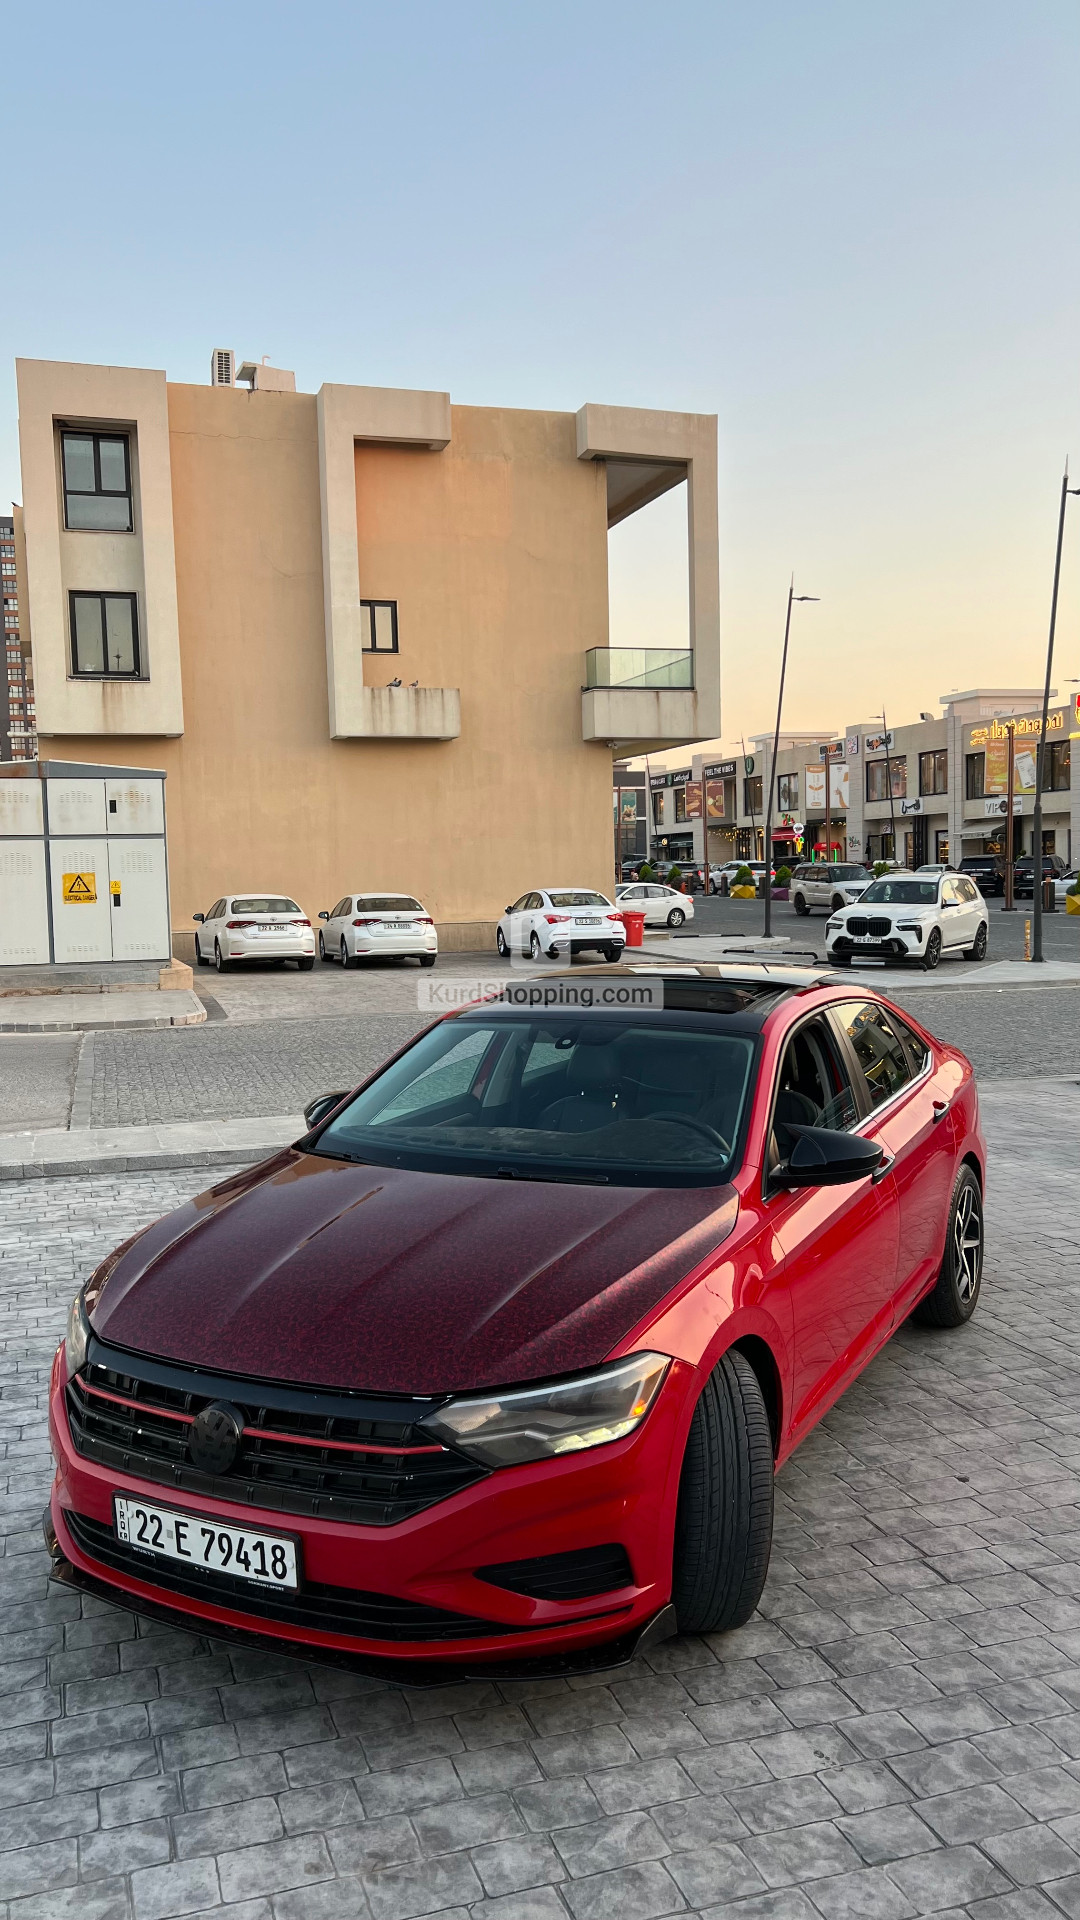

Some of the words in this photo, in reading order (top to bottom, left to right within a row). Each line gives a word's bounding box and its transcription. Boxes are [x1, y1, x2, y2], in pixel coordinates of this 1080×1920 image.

[135, 1508, 165, 1550] 22
[174, 1519, 192, 1558] E
[200, 1526, 288, 1581] 79418
